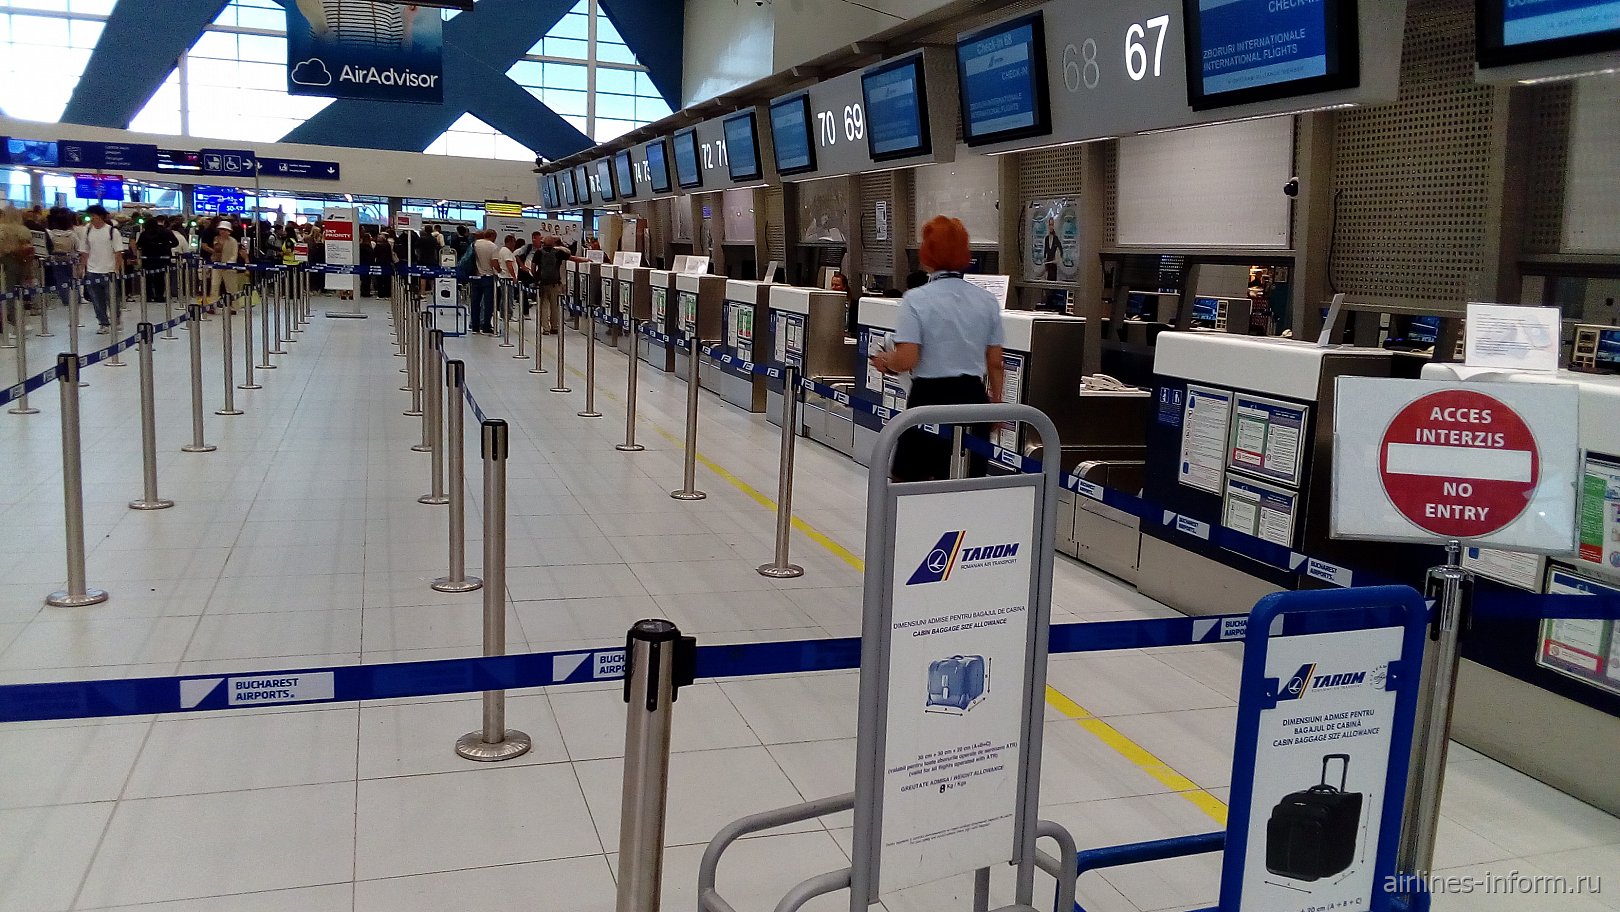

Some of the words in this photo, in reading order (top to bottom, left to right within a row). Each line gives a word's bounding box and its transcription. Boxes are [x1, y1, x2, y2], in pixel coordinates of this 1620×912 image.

[1125, 14, 1169, 81] 67
[1203, 45, 1235, 59] ZBORURI
[1062, 38, 1100, 92] 68
[1203, 51, 1262, 71] INTERNATIONAL
[1263, 43, 1298, 59] FLIGHTS
[339, 64, 439, 88] AirAdvisor
[817, 110, 836, 147] 70
[844, 103, 864, 142] 69
[701, 143, 714, 169] 72
[716, 139, 728, 167] 71
[1429, 406, 1492, 424] ACCES
[1415, 428, 1505, 447] INTERZIS
[1443, 482, 1473, 498] NO
[1424, 503, 1490, 521] ENTRY
[961, 543, 1020, 562] TAROM
[1310, 560, 1338, 573] BUCHAREST
[893, 619, 927, 630] DIMENSIUNI
[928, 615, 950, 625] ADMISE
[950, 612, 973, 622] PENTRU
[998, 607, 1006, 615] DE
[912, 629, 931, 637] CABIN
[931, 624, 960, 635] BAGGAGE
[960, 622, 973, 631] SIZE
[974, 617, 1008, 628] ALLOWANCE
[599, 654, 626, 664] BUCH
[236, 678, 299, 690] BUCHAREST
[1312, 671, 1367, 689] TAROM
[1282, 715, 1323, 726] DIMENSIUNI
[1324, 711, 1349, 721] ADMISE
[1350, 709, 1375, 718] PENTRU
[1272, 737, 1293, 747] CABIN
[1294, 733, 1327, 745] BAGGAGE
[1328, 731, 1341, 740] SIZE
[1341, 727, 1380, 738] ALLOWANCE
[1294, 724, 1325, 735] BAGAJUL
[1326, 723, 1336, 731] DE
[939, 783, 946, 794] 8
